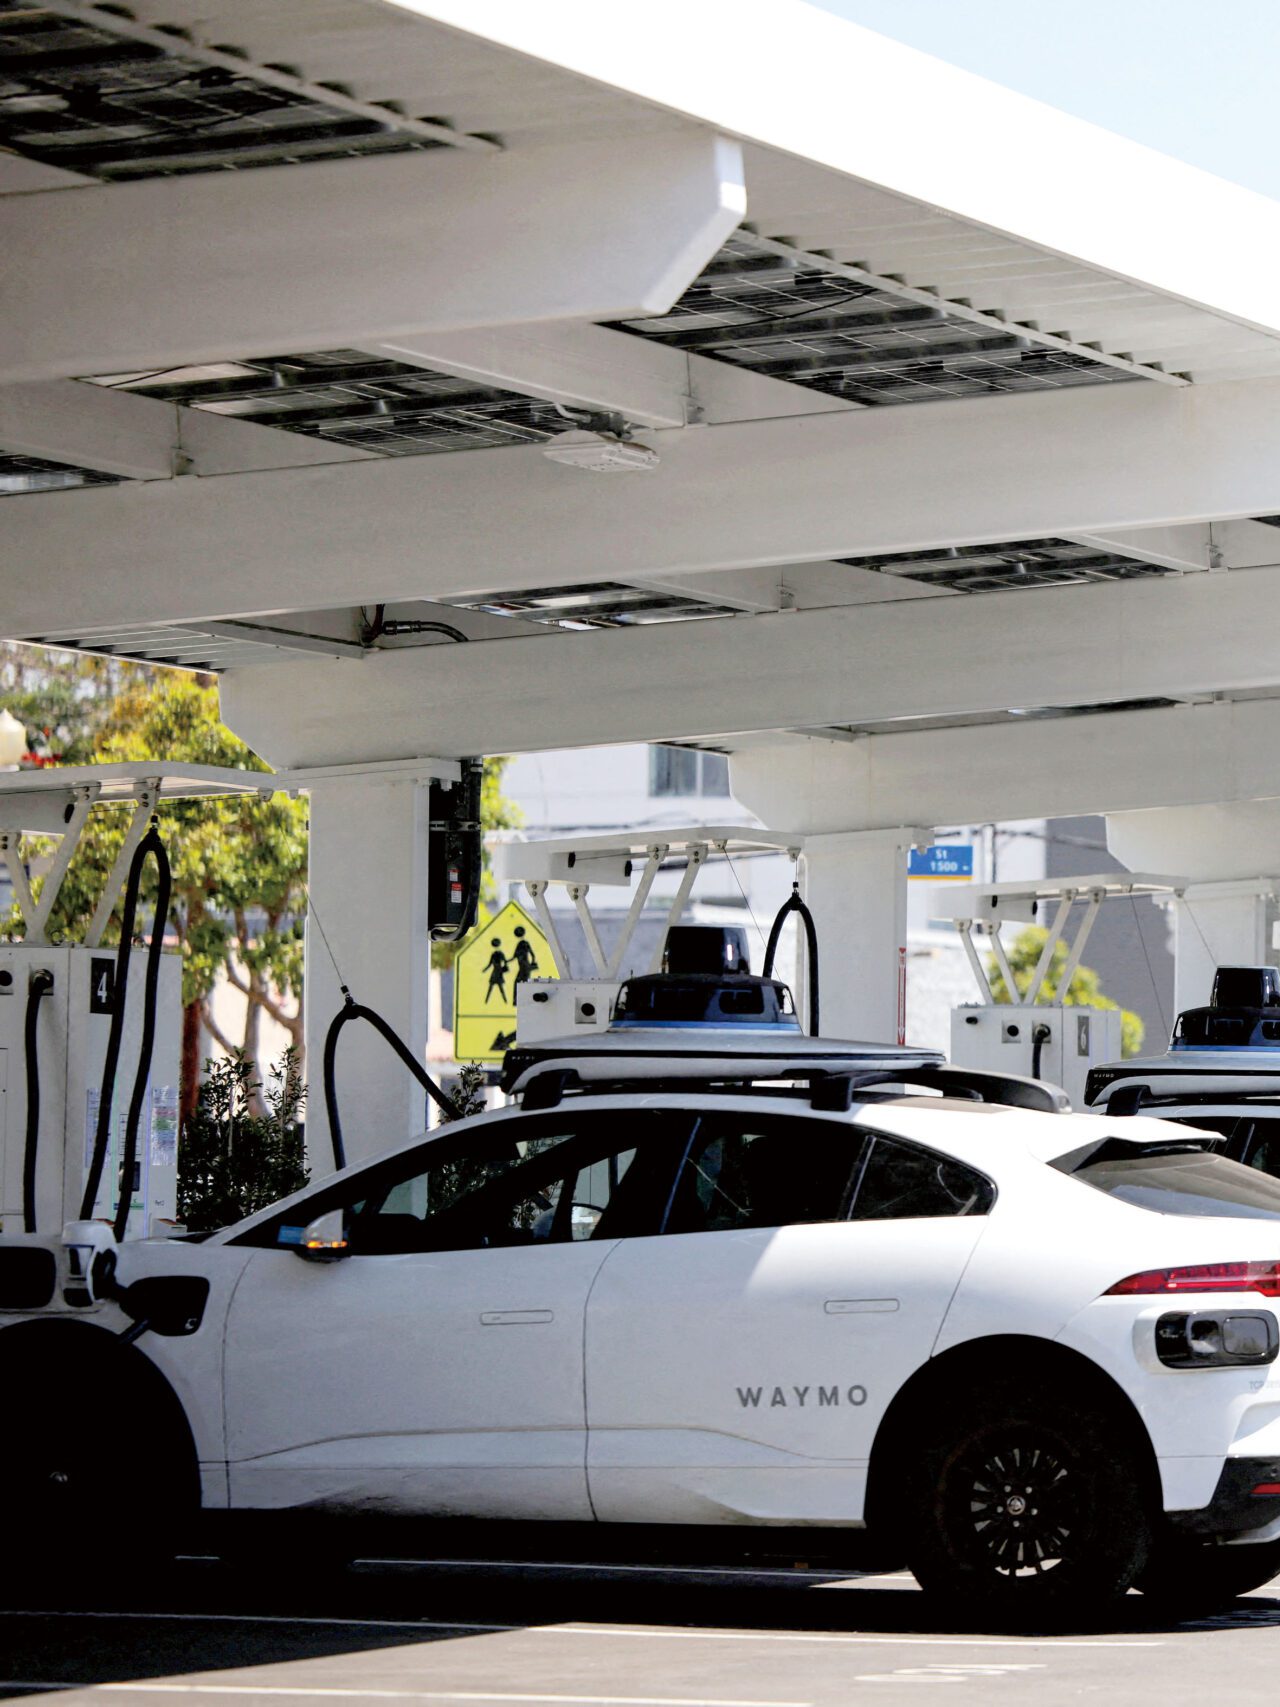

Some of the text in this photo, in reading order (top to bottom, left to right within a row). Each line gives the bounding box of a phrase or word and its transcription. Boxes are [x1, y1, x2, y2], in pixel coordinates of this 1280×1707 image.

[930, 860, 958, 872] 1500
[935, 848, 948, 860] St
[97, 971, 107, 1003] 4
[1080, 1024, 1087, 1050] 6
[735, 1384, 868, 1408] WAYMO
